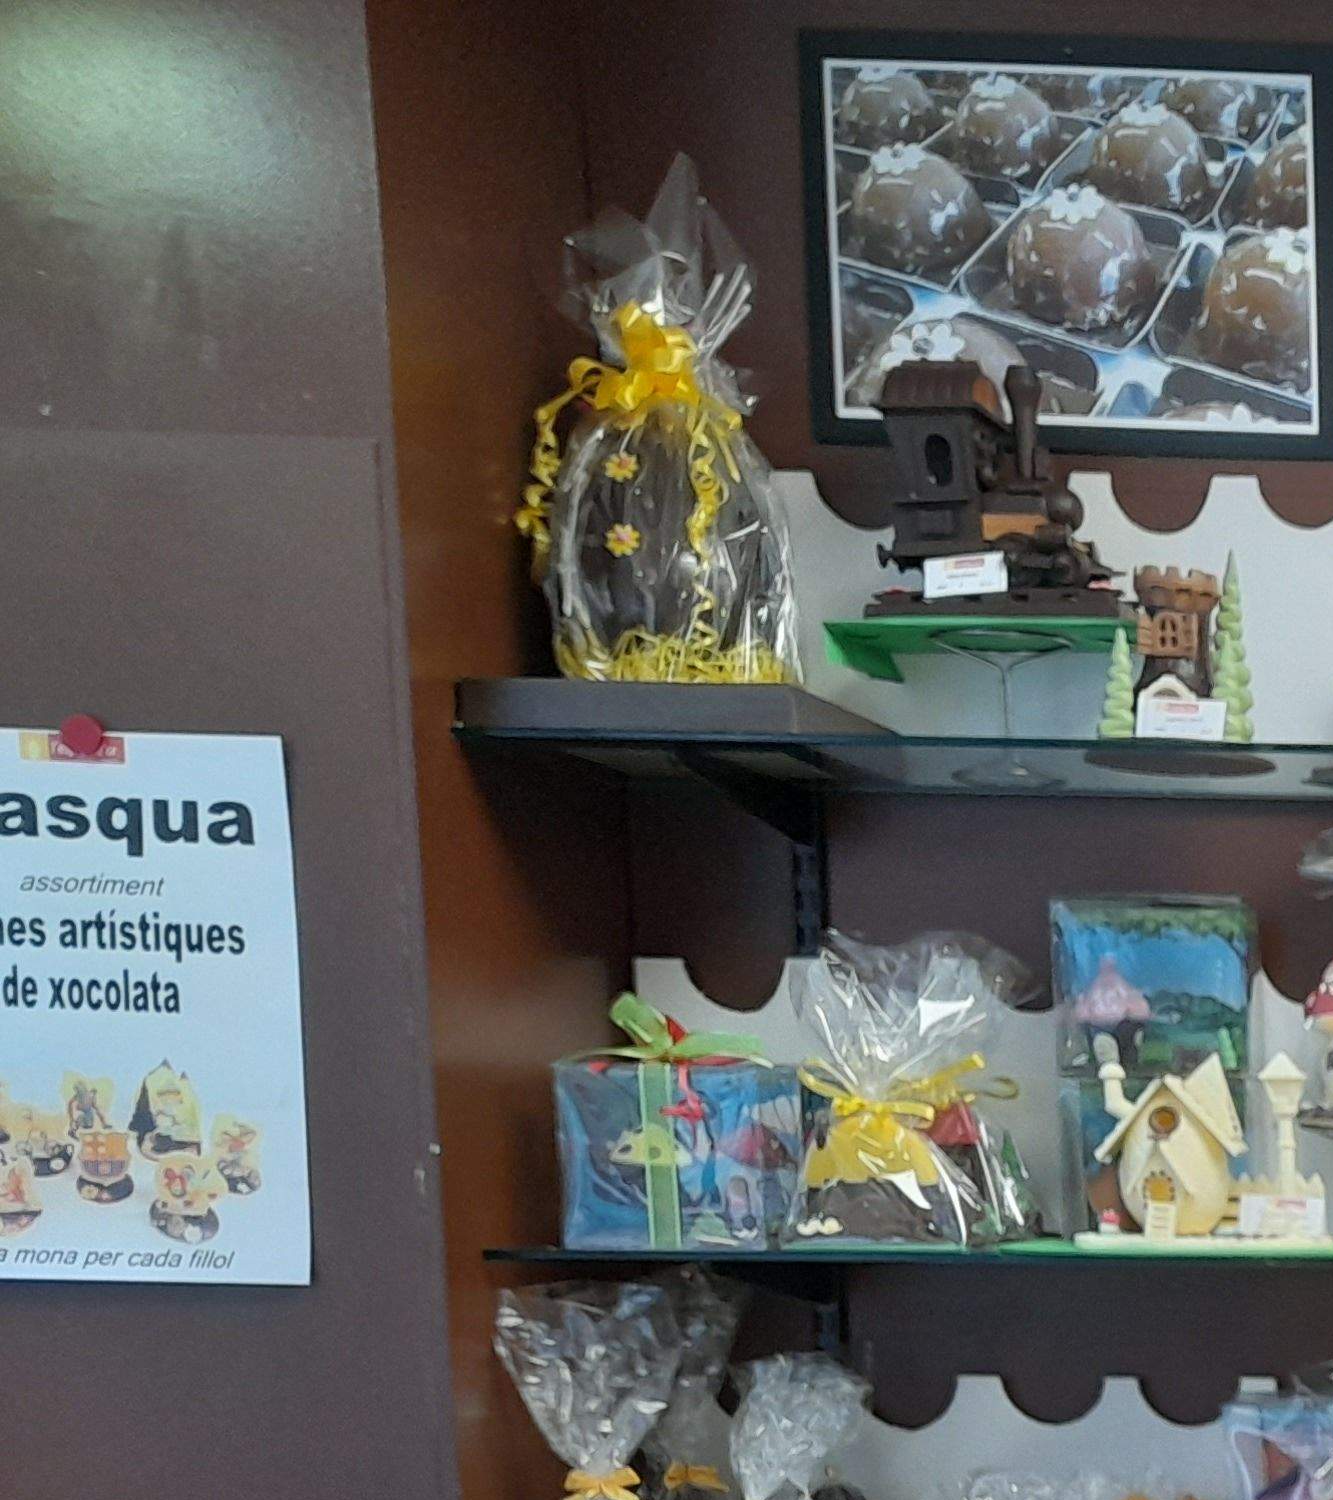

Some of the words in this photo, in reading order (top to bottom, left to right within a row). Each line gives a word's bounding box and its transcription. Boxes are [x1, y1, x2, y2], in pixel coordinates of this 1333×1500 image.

[0, 793, 255, 857] asqua
[20, 873, 165, 896] assortiment
[59, 909, 246, 963] artístiques
[2, 964, 38, 1008] de
[48, 968, 181, 1013] xocolata
[14, 1249, 78, 1265] mona
[82, 1250, 123, 1269] per
[127, 1250, 182, 1268] cada
[188, 1250, 235, 1269] fillol
